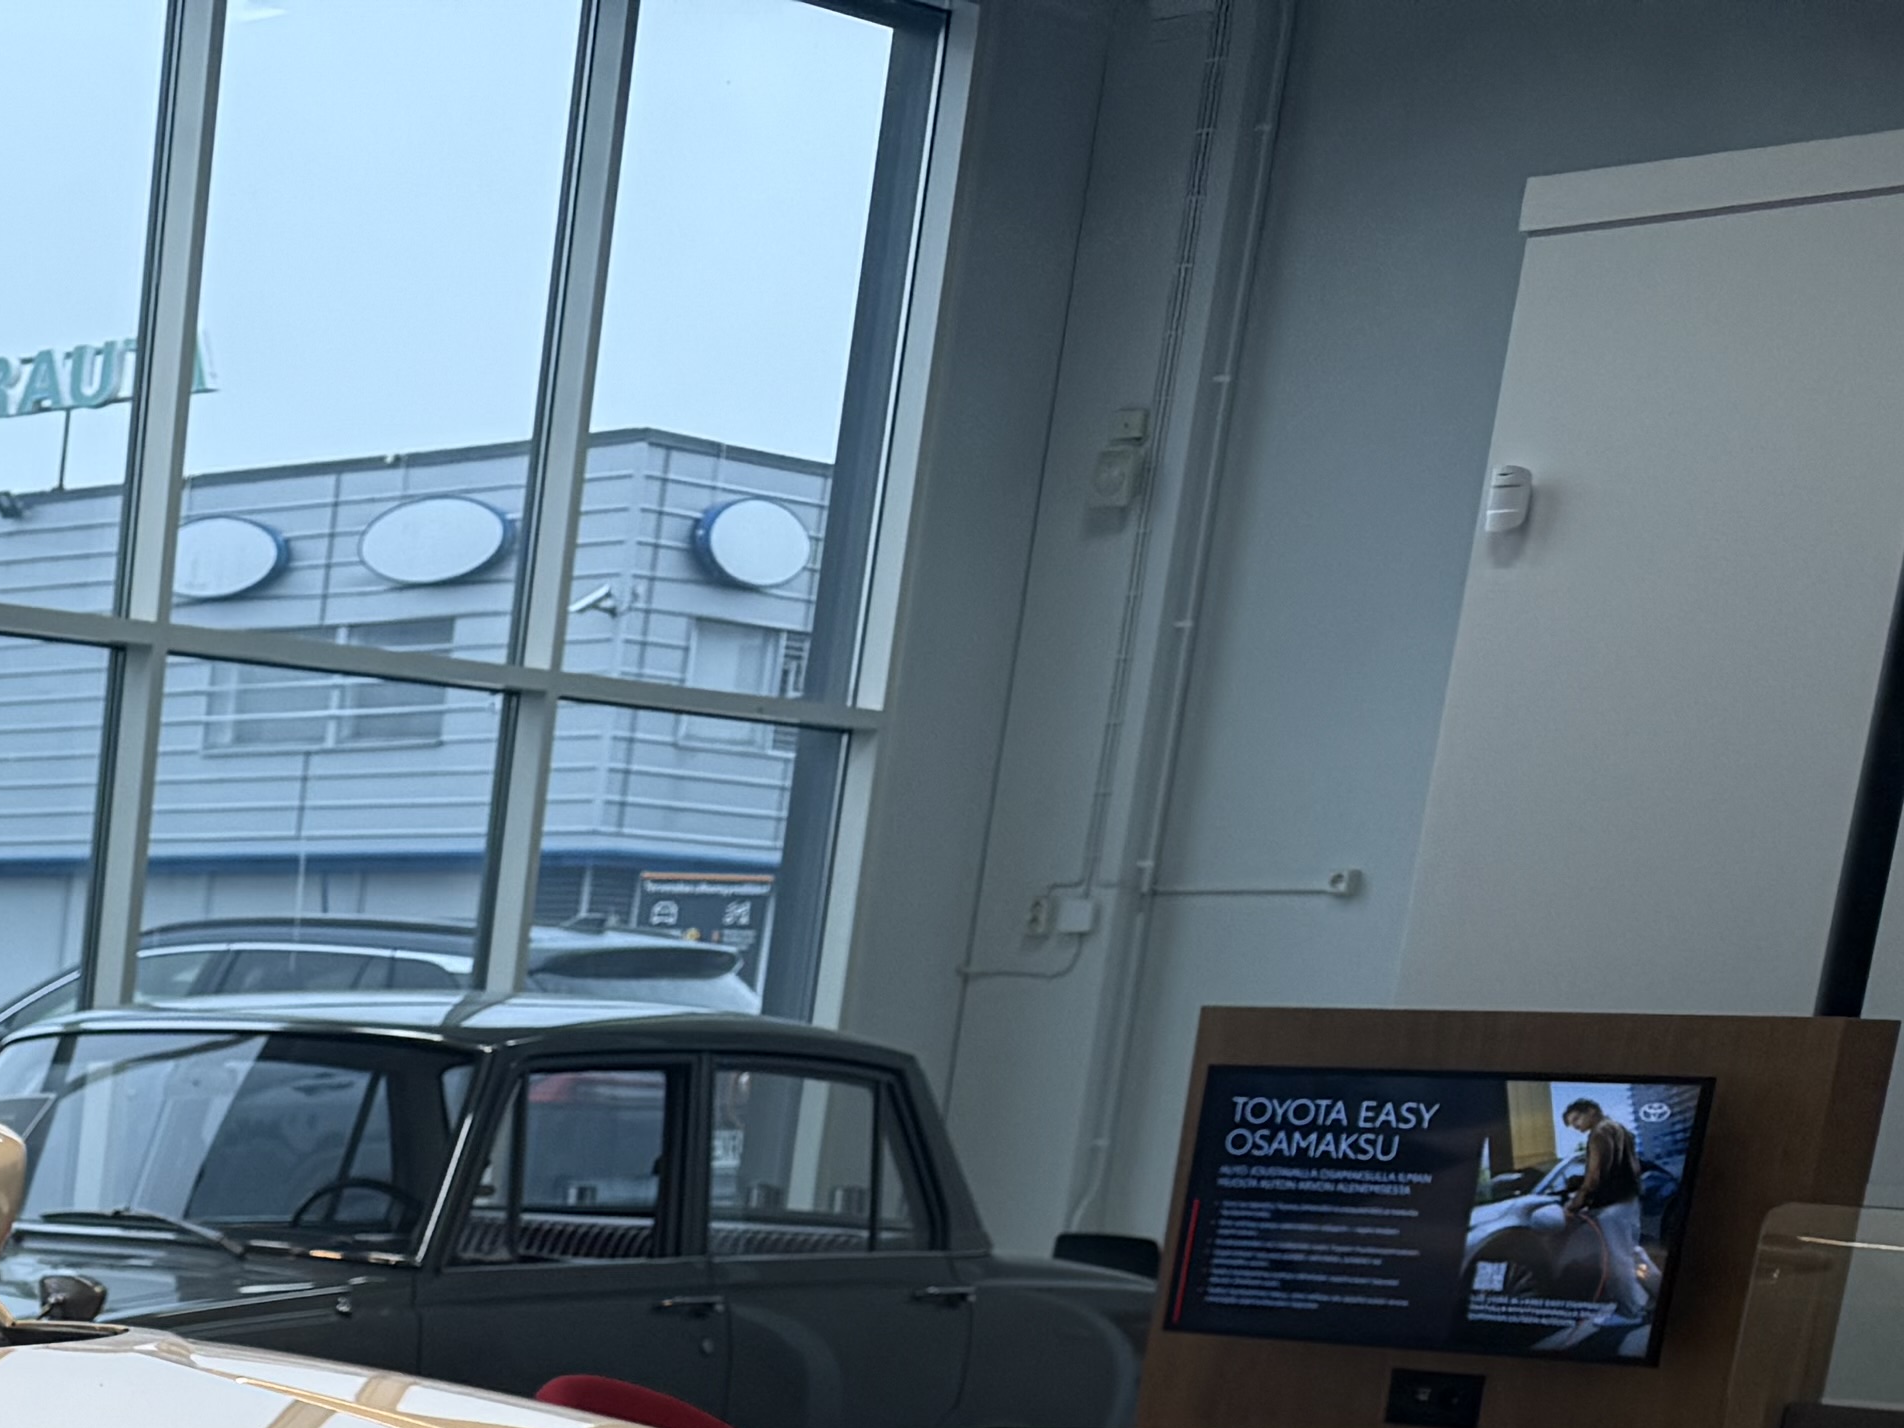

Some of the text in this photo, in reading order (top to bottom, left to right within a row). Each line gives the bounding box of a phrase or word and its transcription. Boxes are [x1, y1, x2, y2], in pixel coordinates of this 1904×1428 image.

[1232, 1096, 1441, 1130] TOYOTA EASY
[1224, 1128, 1401, 1162] OSAMAKSU
